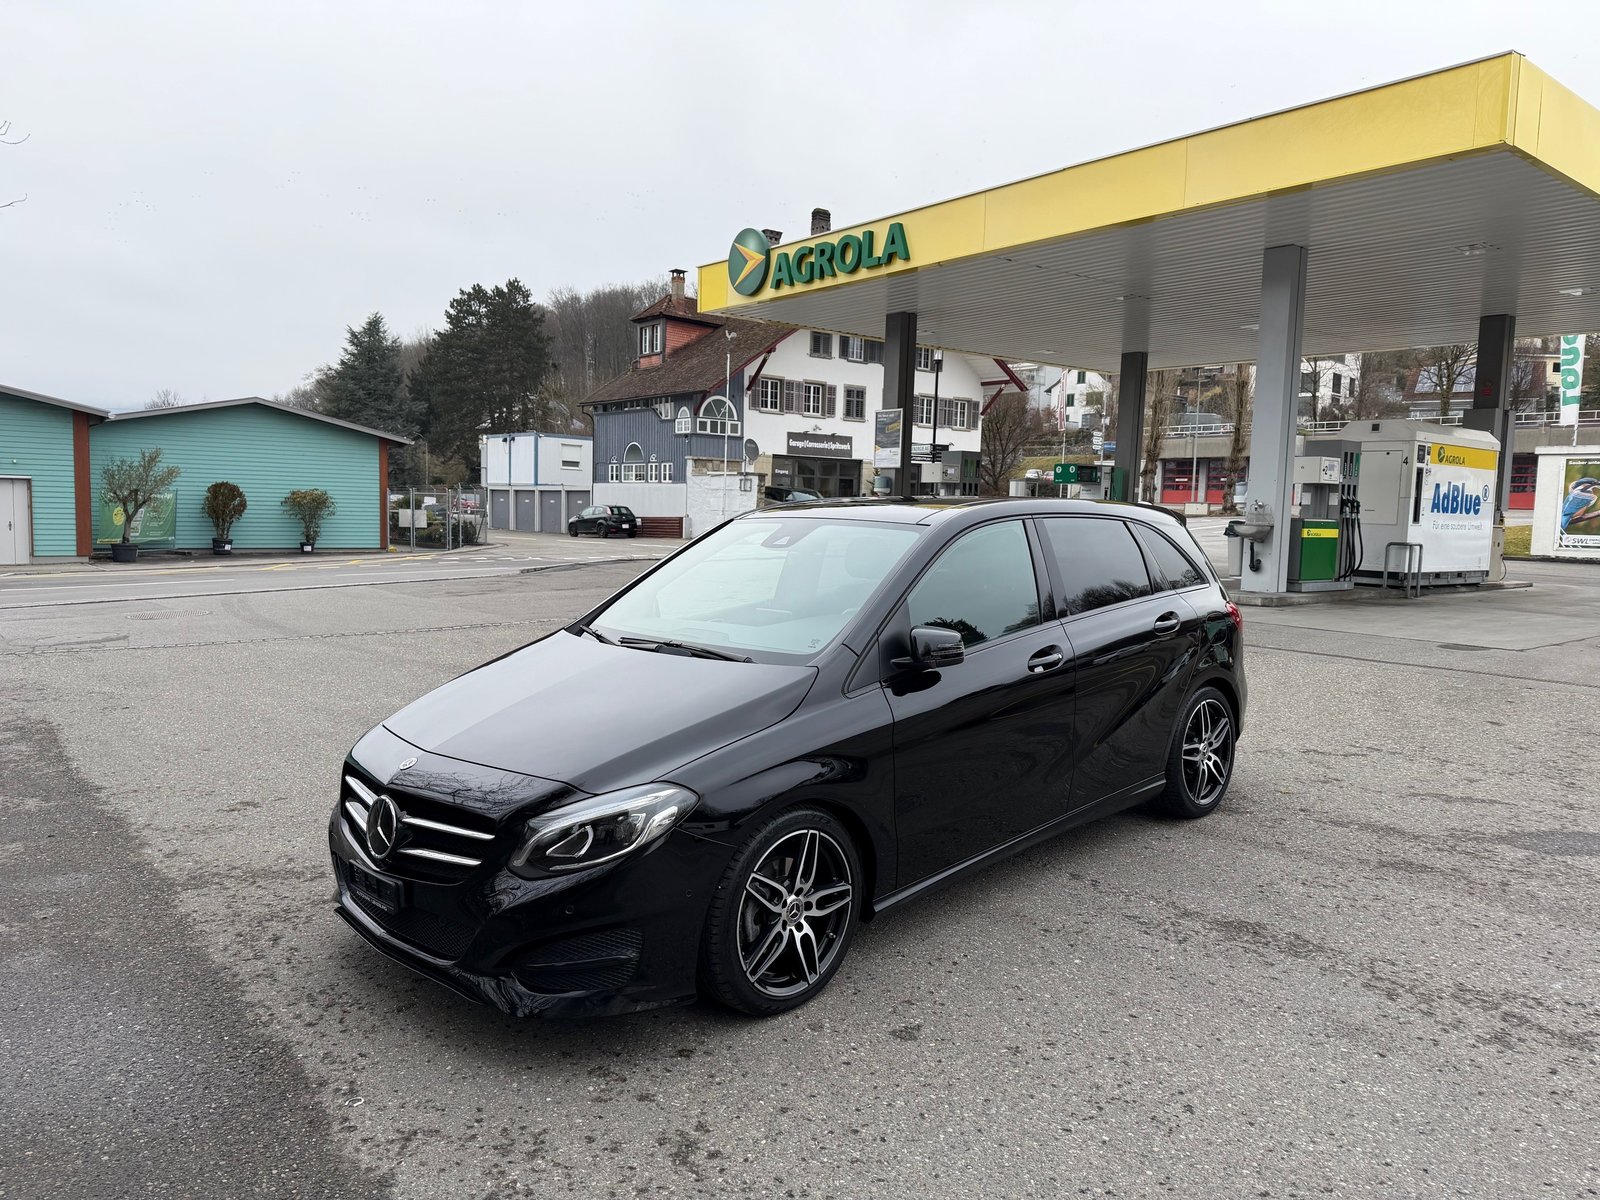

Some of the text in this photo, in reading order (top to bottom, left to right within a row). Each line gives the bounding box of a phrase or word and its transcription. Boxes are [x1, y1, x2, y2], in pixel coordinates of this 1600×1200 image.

[769, 222, 910, 289] AGROLA
[1402, 456, 1409, 466] 4
[1444, 454, 1466, 466] AGROLA
